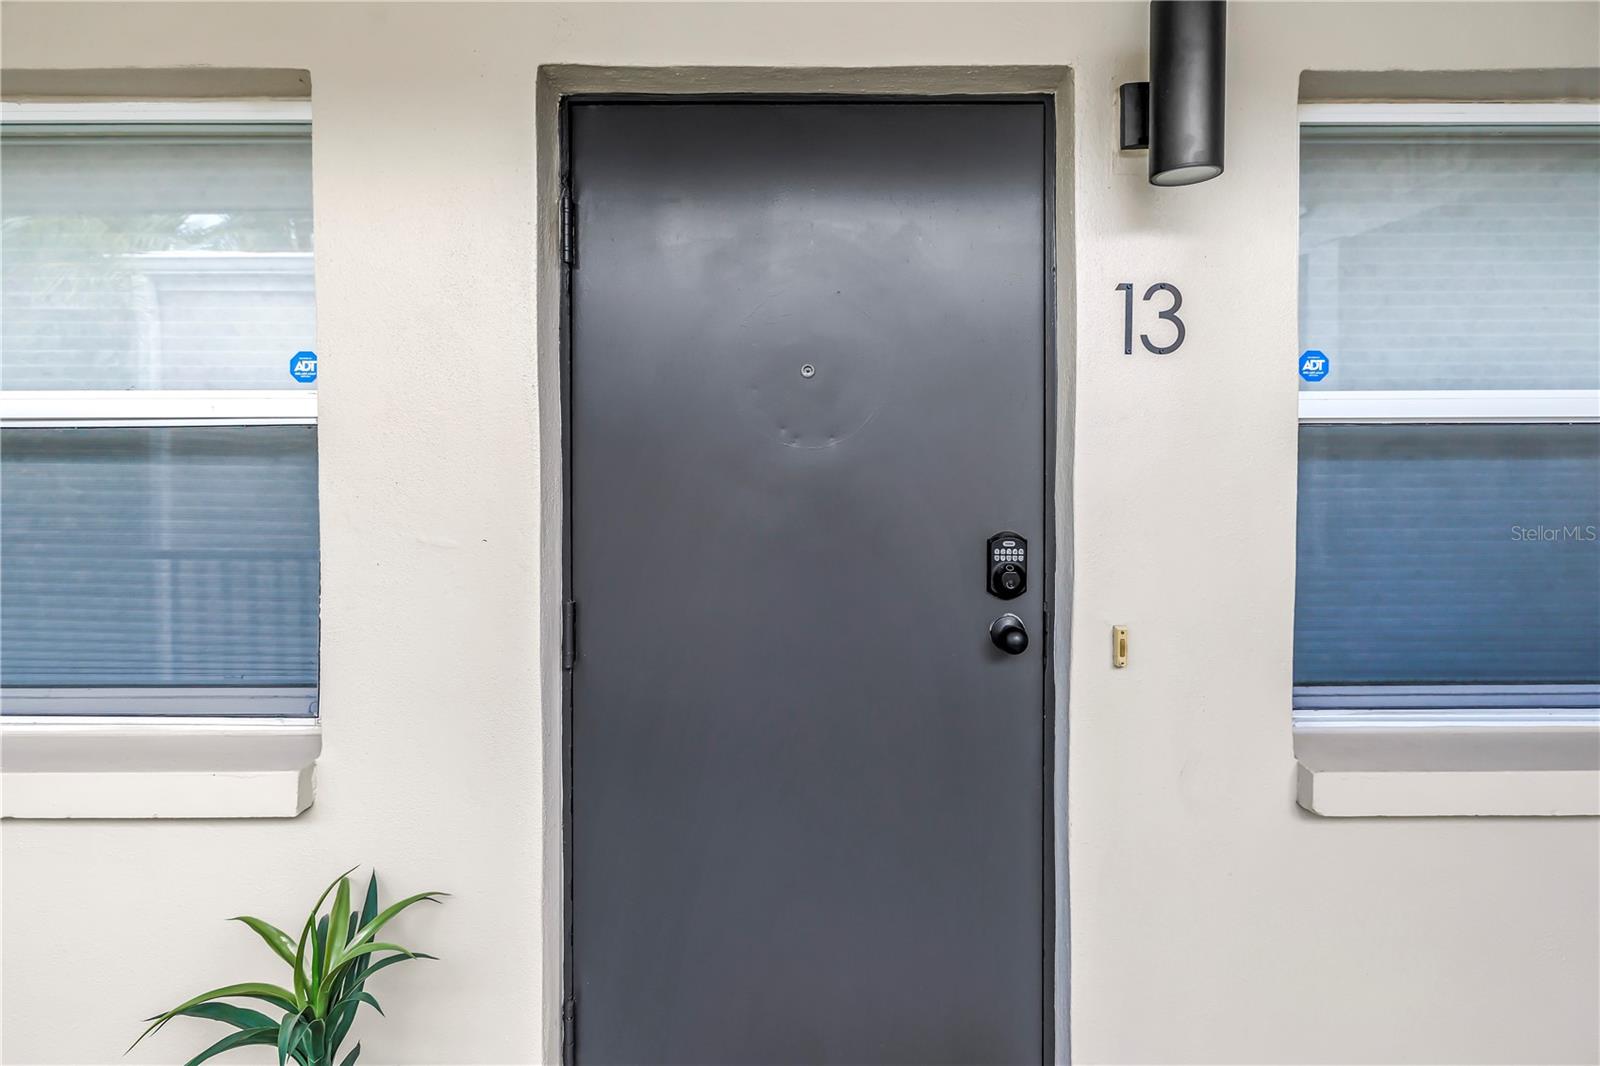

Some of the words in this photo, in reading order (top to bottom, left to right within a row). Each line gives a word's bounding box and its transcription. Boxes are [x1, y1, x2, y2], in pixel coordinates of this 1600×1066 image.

[1115, 282, 1186, 355] 13
[294, 360, 317, 371] ADT
[1302, 359, 1326, 370] ADT
